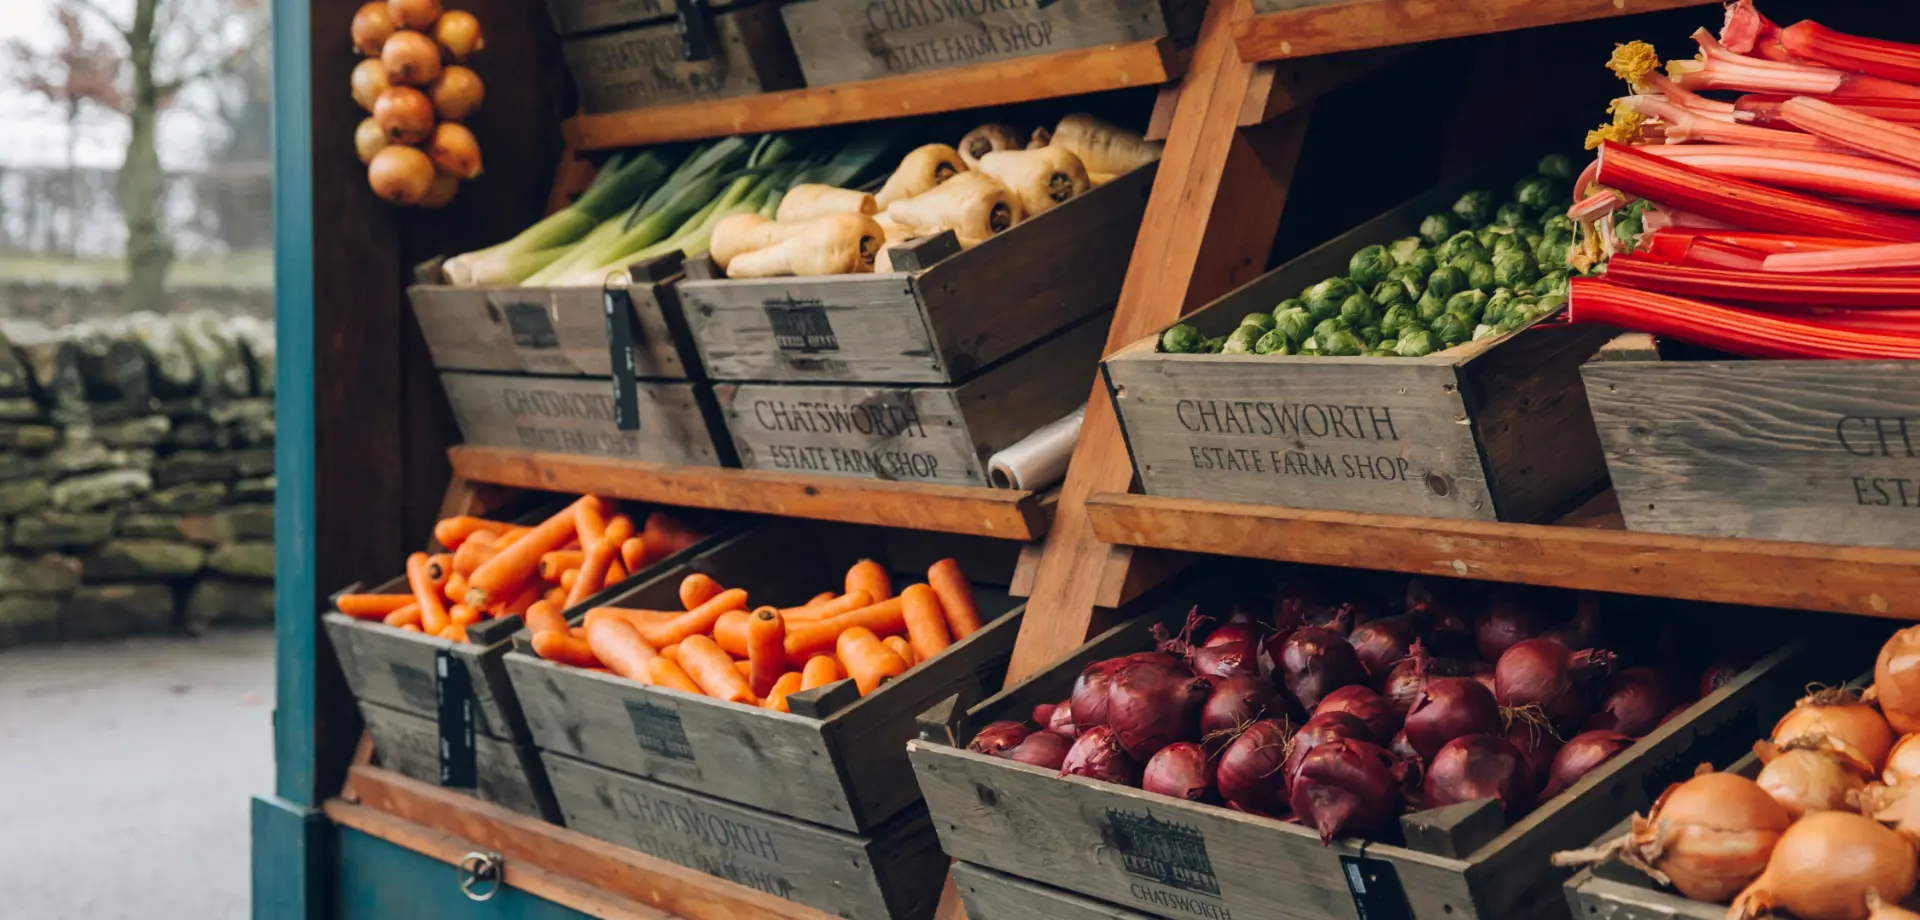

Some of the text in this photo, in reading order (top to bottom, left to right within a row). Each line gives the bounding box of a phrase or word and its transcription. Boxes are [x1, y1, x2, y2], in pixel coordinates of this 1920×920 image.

[865, 0, 1033, 34] CHATSWO
[943, 33, 998, 62] FARM
[1000, 20, 1053, 53] SHOP
[502, 388, 616, 422] CHATSWORT
[754, 400, 928, 438] CHATSWORTH
[1176, 399, 1400, 441] CHATSWORTH
[769, 444, 939, 478] ESTATE FARM SHOP
[1189, 446, 1410, 482] ESTATE FARM SHOP
[1850, 476, 1920, 508] EST
[619, 788, 781, 863] CHATSWORTH
[1130, 883, 1233, 920] CHATSWORTH
